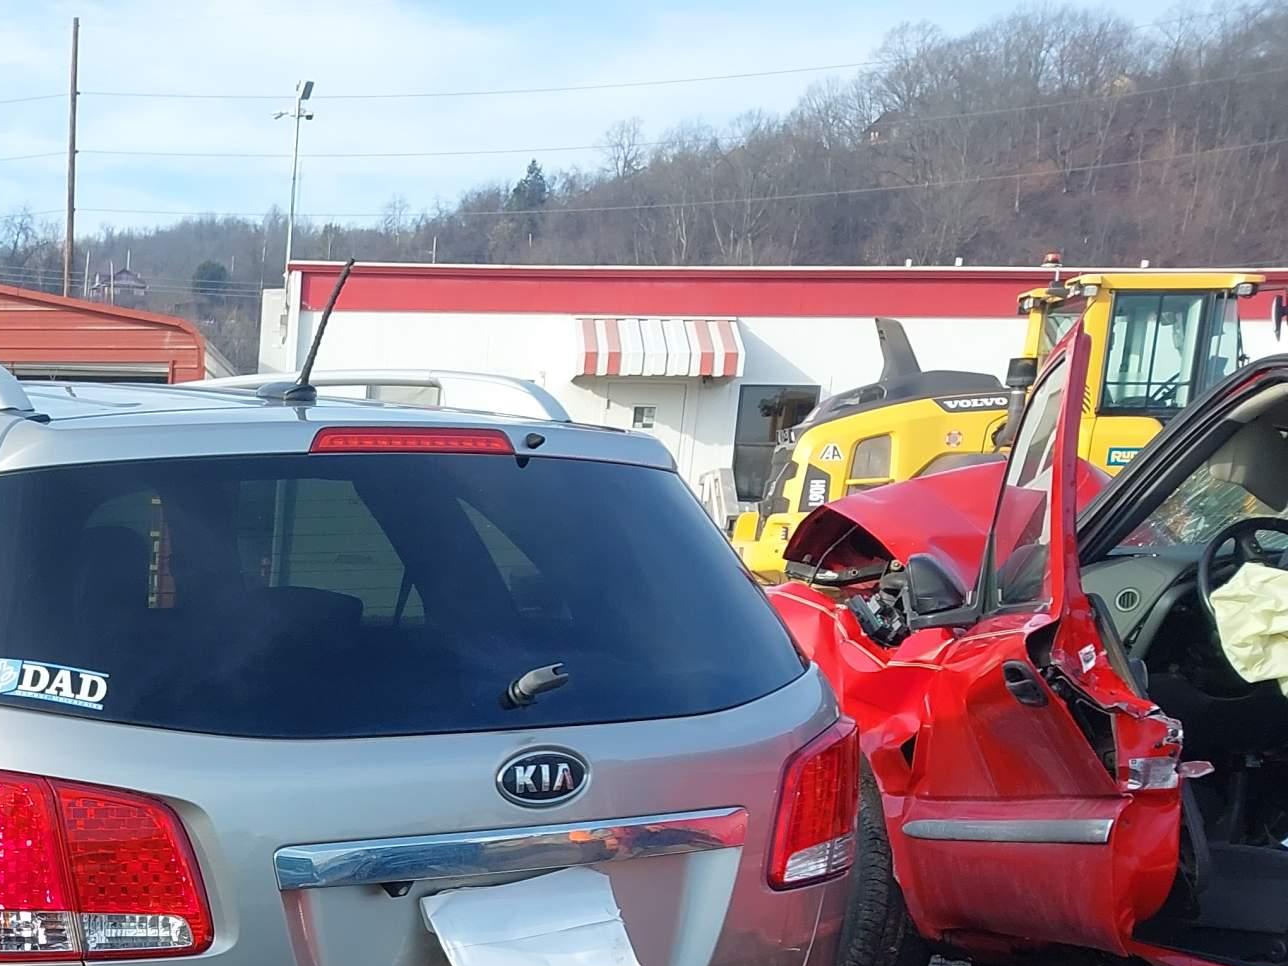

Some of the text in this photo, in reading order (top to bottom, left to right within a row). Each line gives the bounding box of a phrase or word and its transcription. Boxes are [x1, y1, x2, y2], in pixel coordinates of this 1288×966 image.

[943, 397, 1008, 409] VOLVO
[808, 480, 826, 506] L90H
[17, 663, 107, 703] DAD
[514, 763, 574, 793] KIA
